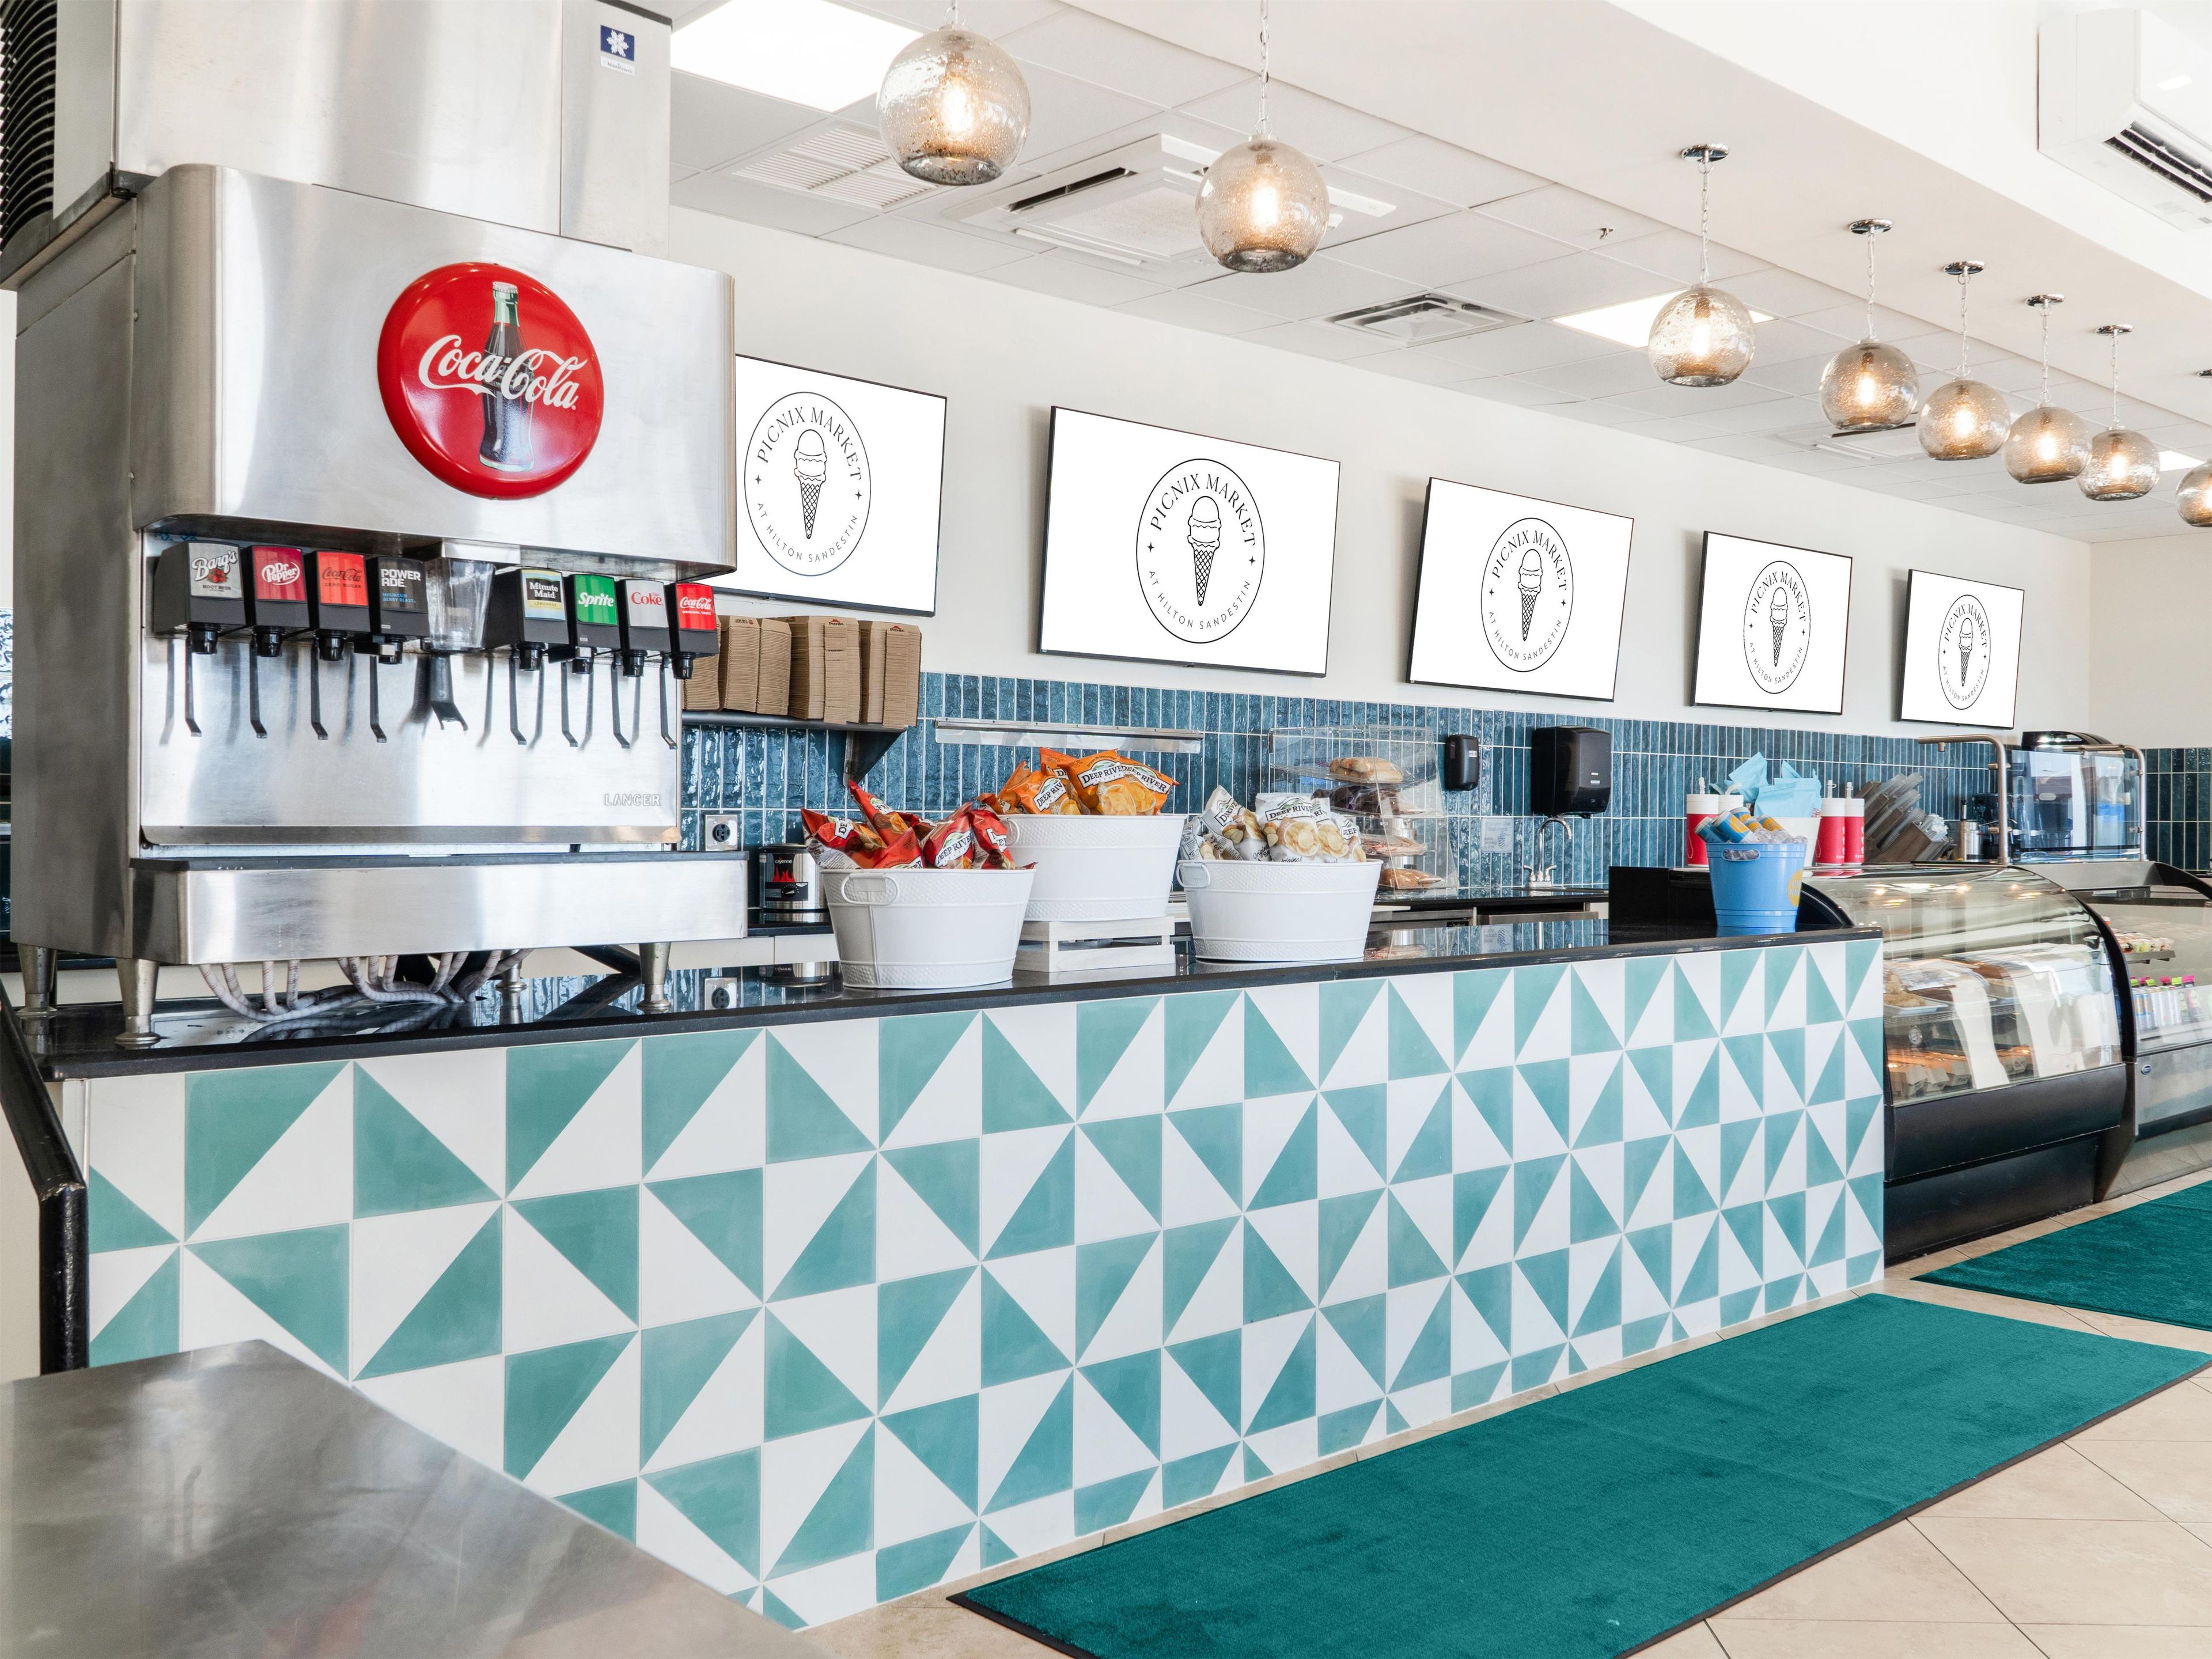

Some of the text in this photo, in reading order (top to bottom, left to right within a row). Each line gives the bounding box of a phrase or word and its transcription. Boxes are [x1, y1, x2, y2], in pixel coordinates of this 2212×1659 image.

[418, 335, 588, 410] Coca-Cola
[757, 407, 862, 480] PICNIX MARKET
[1150, 473, 1256, 546] PICNIX MARKET
[757, 503, 857, 563] AT HILTON SANDESTIN
[192, 550, 238, 581] Barq's
[274, 562, 289, 571] Dr
[1492, 530, 1567, 591] PICNIX MARKET
[266, 565, 297, 582] Pepper
[323, 567, 362, 582] Coca-Cola
[381, 569, 421, 581] POWER
[381, 578, 406, 587] ADE
[529, 582, 558, 592] Minute
[535, 590, 556, 599] Maid
[578, 592, 614, 607] Sprite
[631, 592, 662, 605] Coke
[680, 597, 712, 610] Coca-Cola
[1149, 570, 1250, 629] AT HILTON SANDESTIN
[1751, 571, 1806, 622] PICNIX MARKET
[1944, 604, 1987, 648] PICNIX MARKET
[1489, 611, 1561, 661] AT HILTON SANDESTIN
[1753, 658, 1772, 683] HILTON
[1774, 647, 1802, 684] SANDESTIN
[1943, 666, 1984, 702] AT HILTON SANDESTIN
[1082, 766, 1122, 784] DEEP RIVE
[1141, 775, 1167, 791] RIVER
[604, 793, 661, 806] LANCER
[1037, 791, 1051, 807] DEEP
[1052, 782, 1063, 795] RIV
[1269, 809, 1291, 819] DEEP
